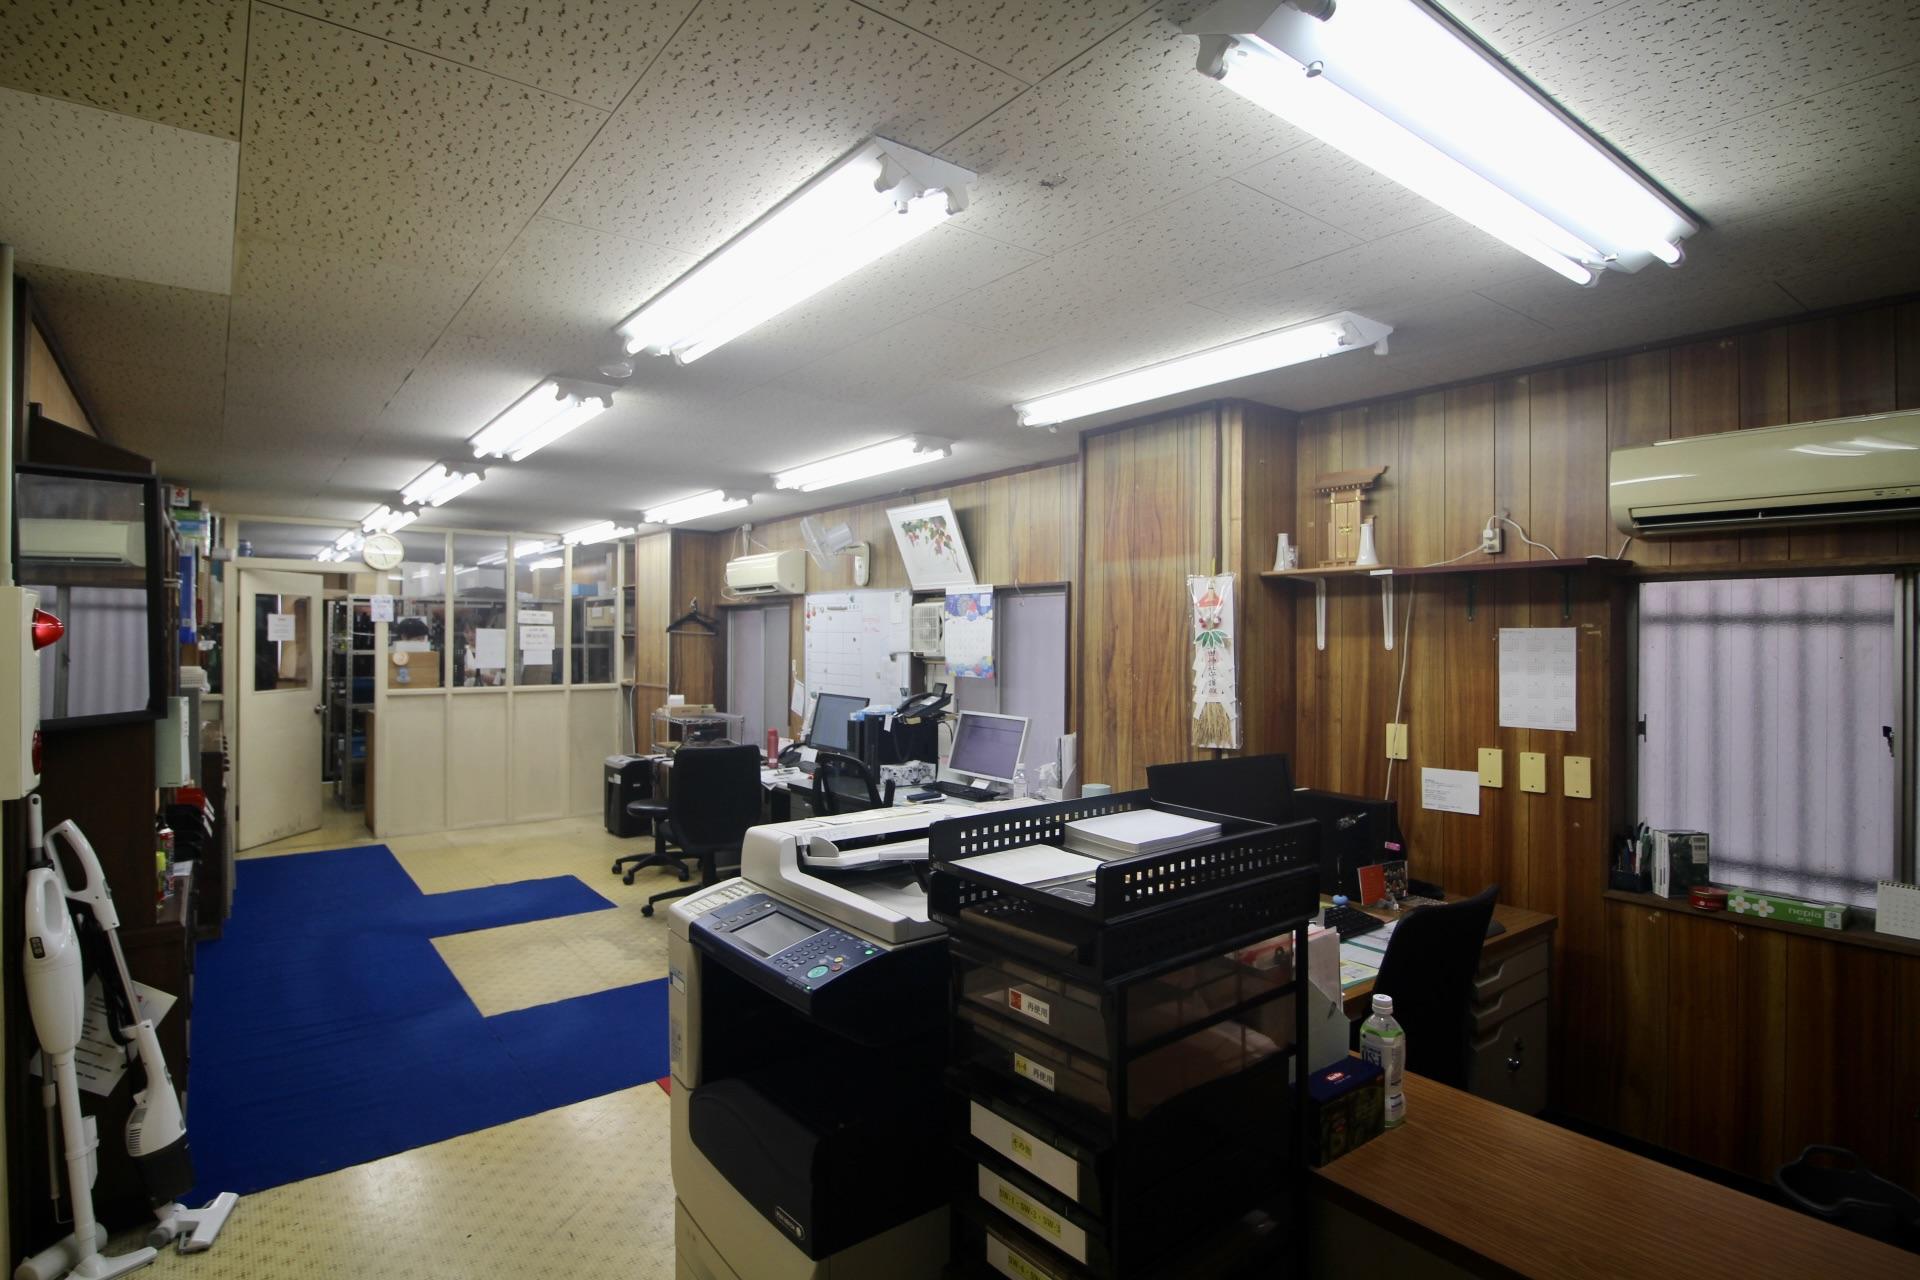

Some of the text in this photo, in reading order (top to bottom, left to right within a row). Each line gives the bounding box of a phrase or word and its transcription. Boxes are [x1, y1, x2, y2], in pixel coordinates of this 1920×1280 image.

[1788, 907, 1822, 919] nepia
[1027, 1001, 1048, 1018] 再使用
[1033, 1068, 1054, 1086] 再使用
